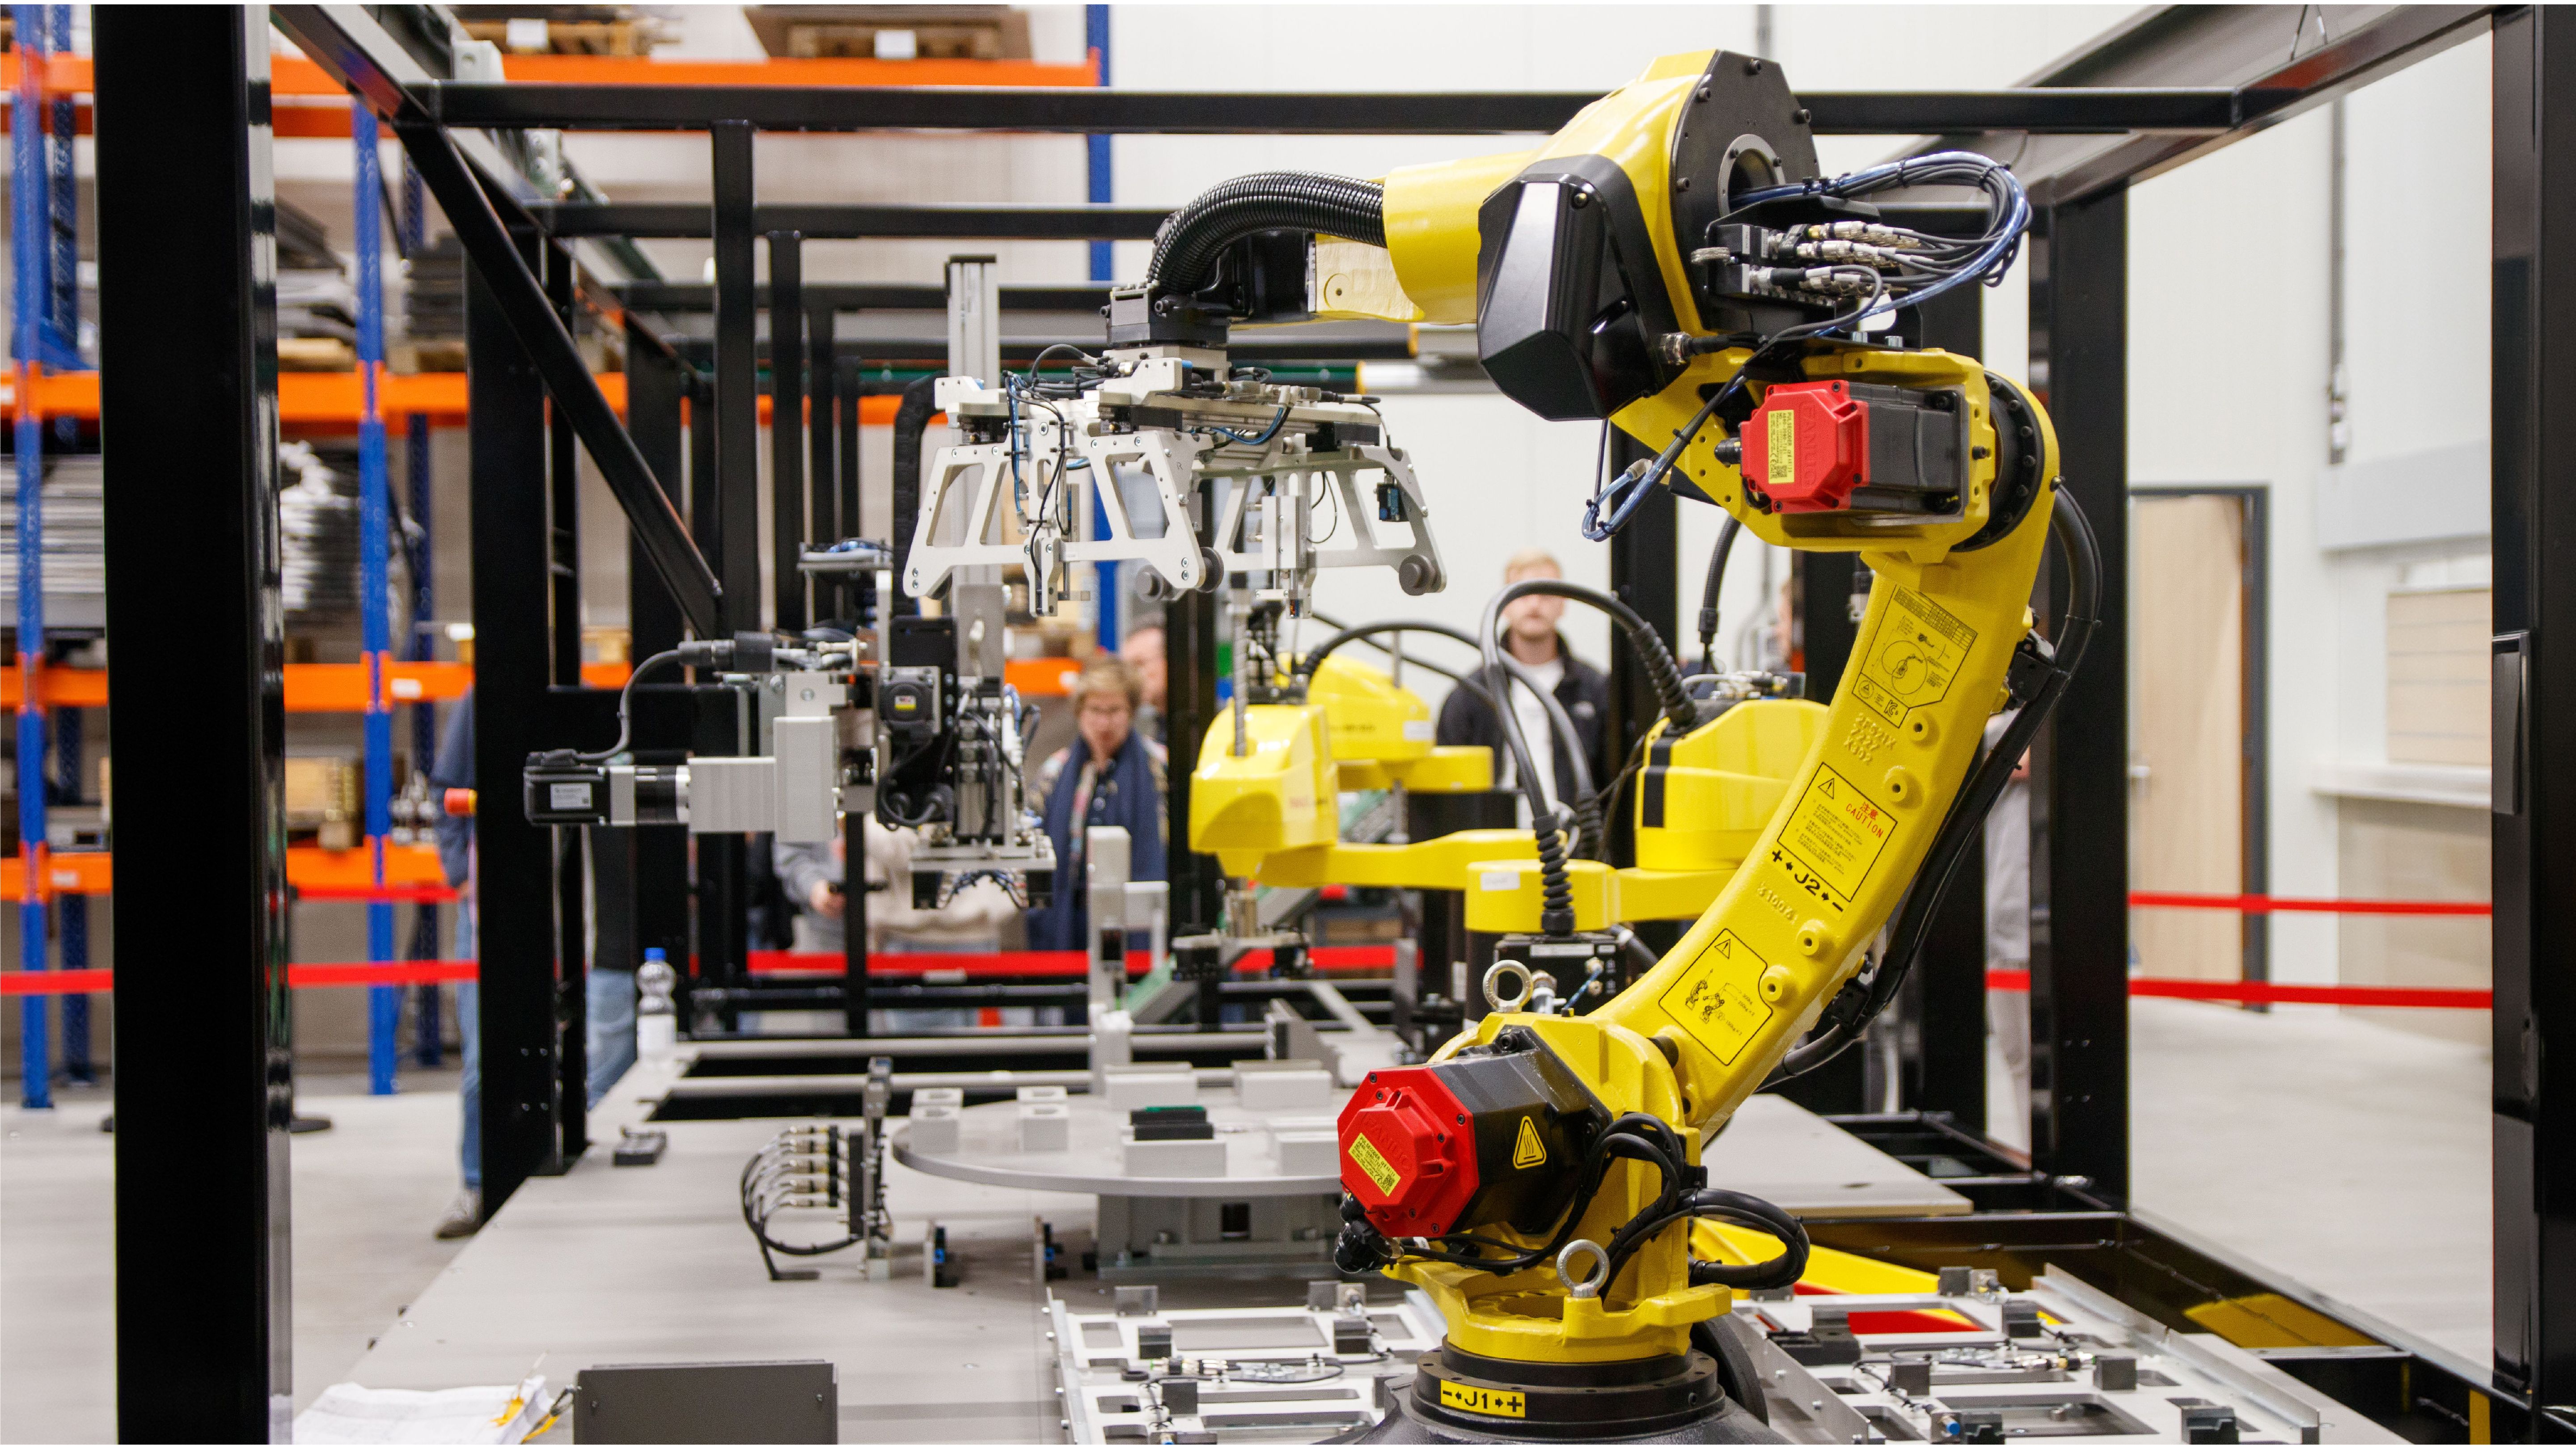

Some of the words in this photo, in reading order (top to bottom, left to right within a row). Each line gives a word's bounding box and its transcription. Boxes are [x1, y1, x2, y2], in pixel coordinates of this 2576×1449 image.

[1846, 804, 1883, 837] CAUTION
[1860, 802, 1878, 820] 注意
[1795, 874, 1820, 895] J2
[1465, 1391, 1487, 1409] J1
